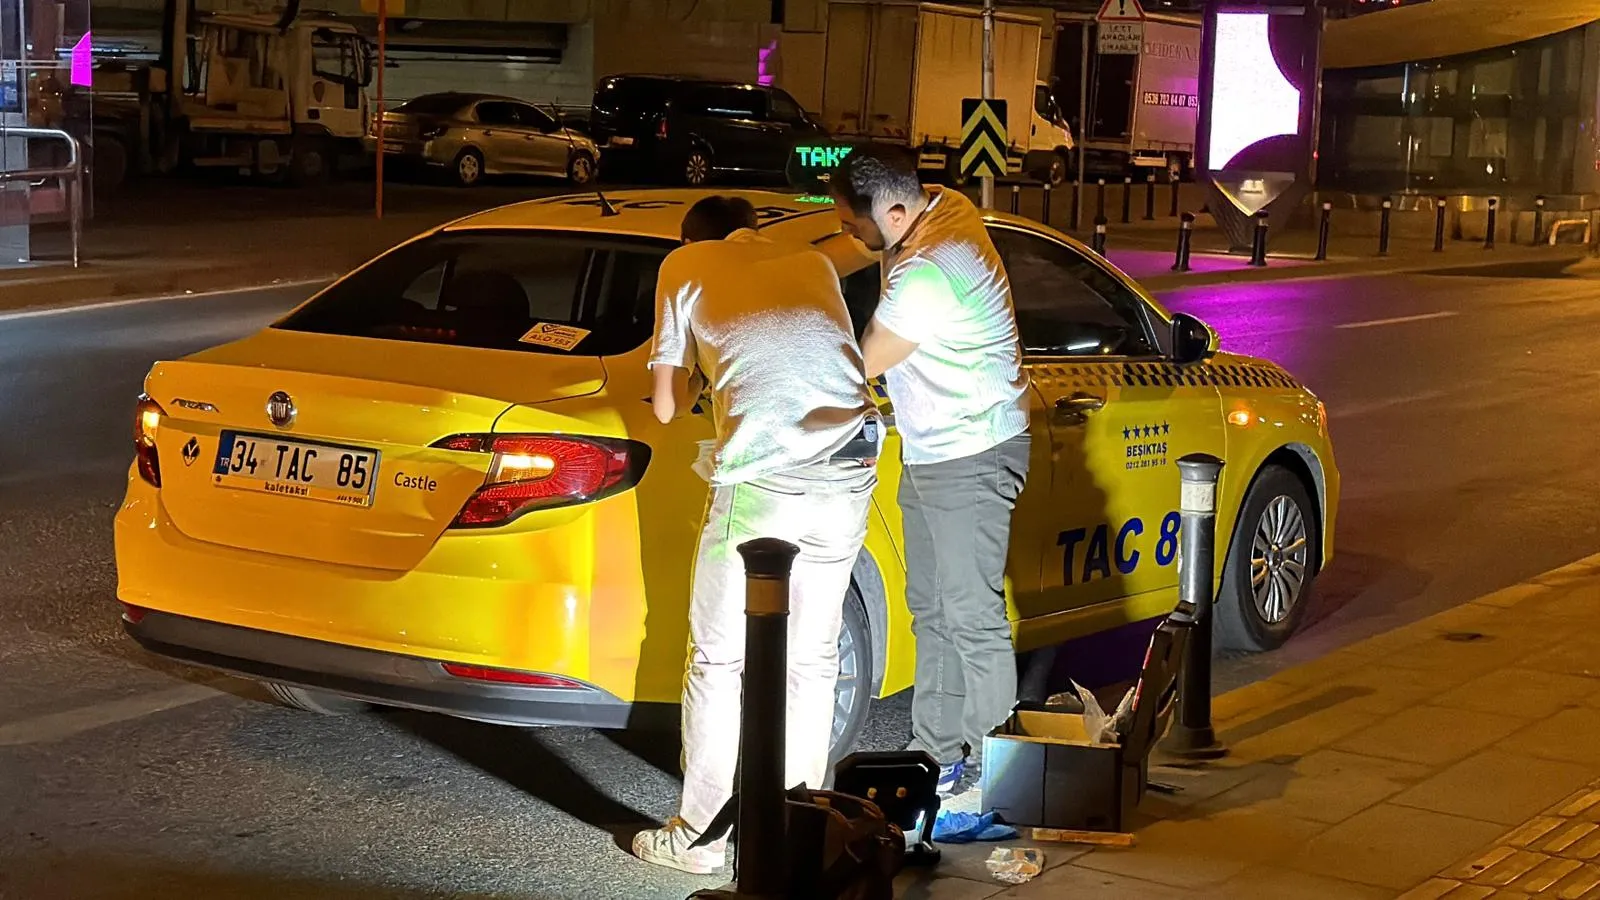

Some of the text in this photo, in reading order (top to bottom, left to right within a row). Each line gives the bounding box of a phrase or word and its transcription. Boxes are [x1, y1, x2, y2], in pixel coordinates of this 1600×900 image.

[220, 440, 368, 489] TR 34 TAC 85
[394, 471, 437, 491] Castle
[1056, 511, 1181, 586] TAC 8
